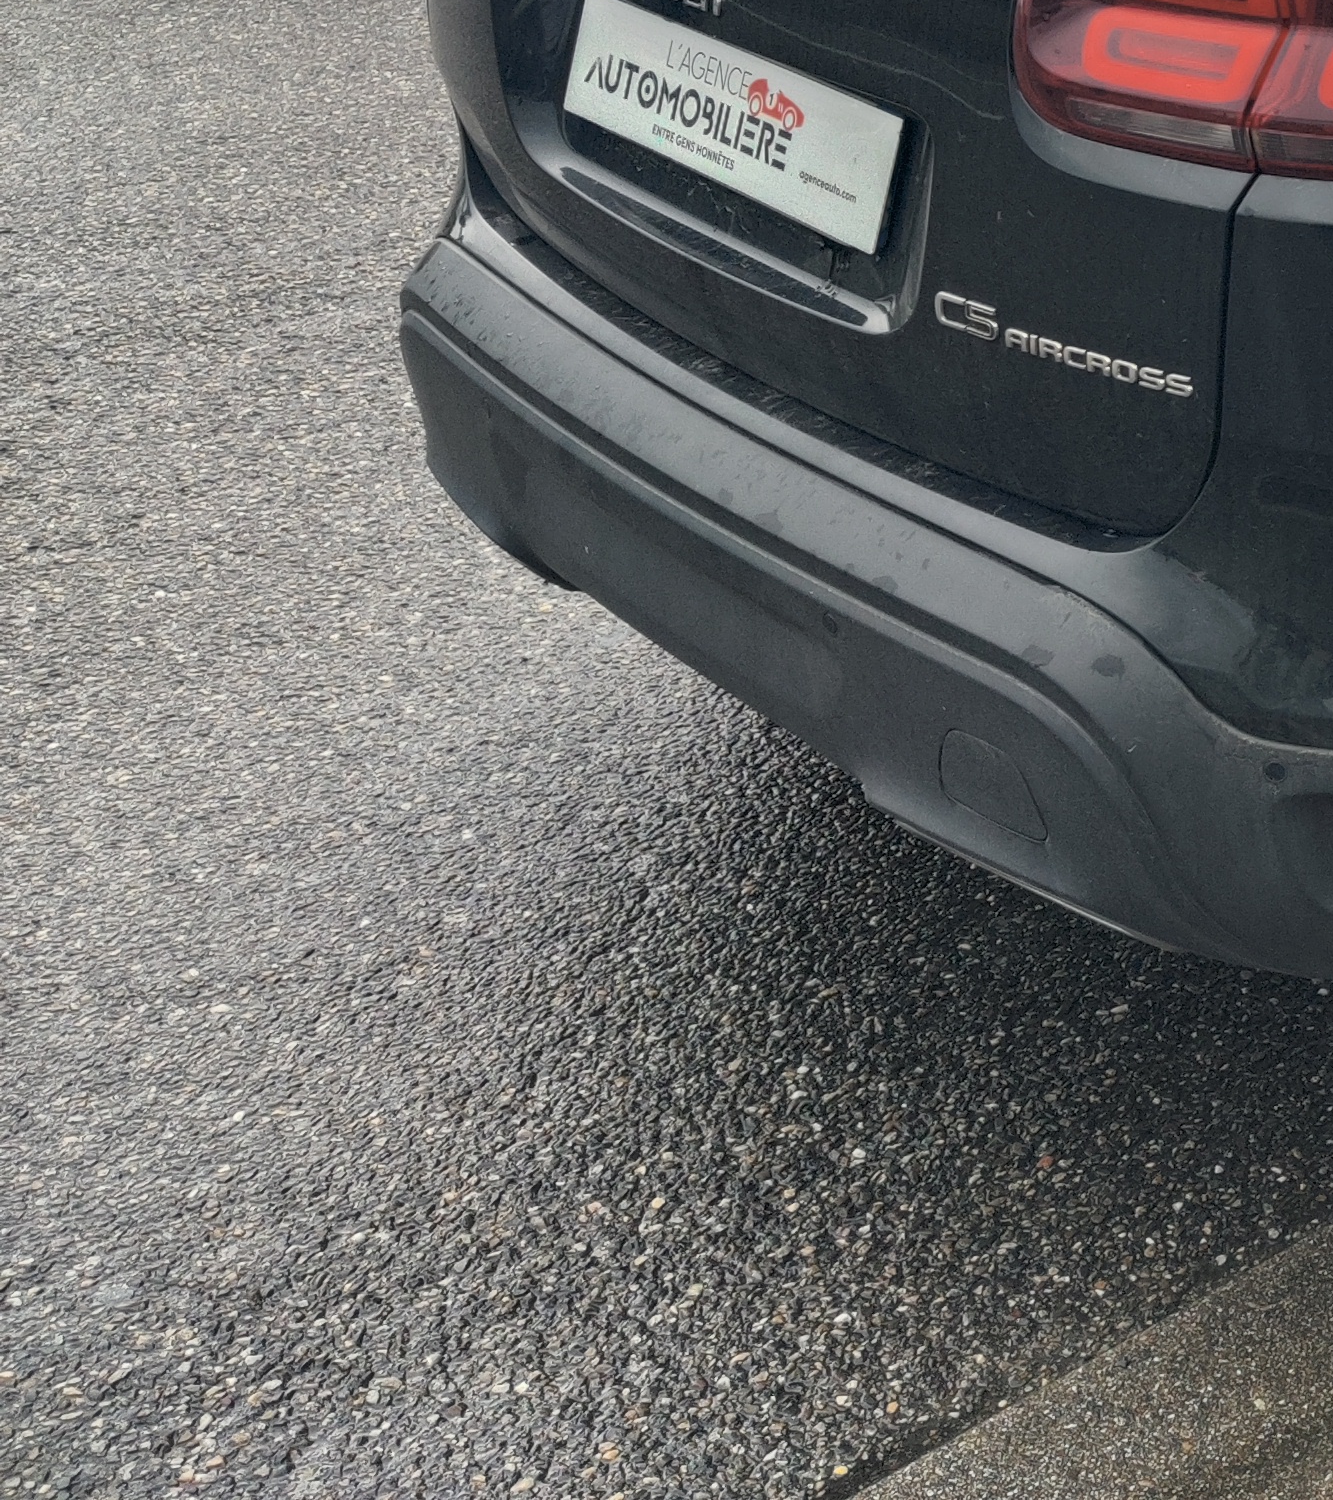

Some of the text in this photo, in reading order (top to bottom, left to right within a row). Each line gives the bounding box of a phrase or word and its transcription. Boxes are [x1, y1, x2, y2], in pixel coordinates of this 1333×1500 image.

[665, 39, 754, 101] L'AGENCE
[651, 124, 736, 172] ENTRE GENS HONNÊTES
[799, 170, 858, 203] agenceauto.com
[934, 290, 1195, 399] C5 AIRCROSS
